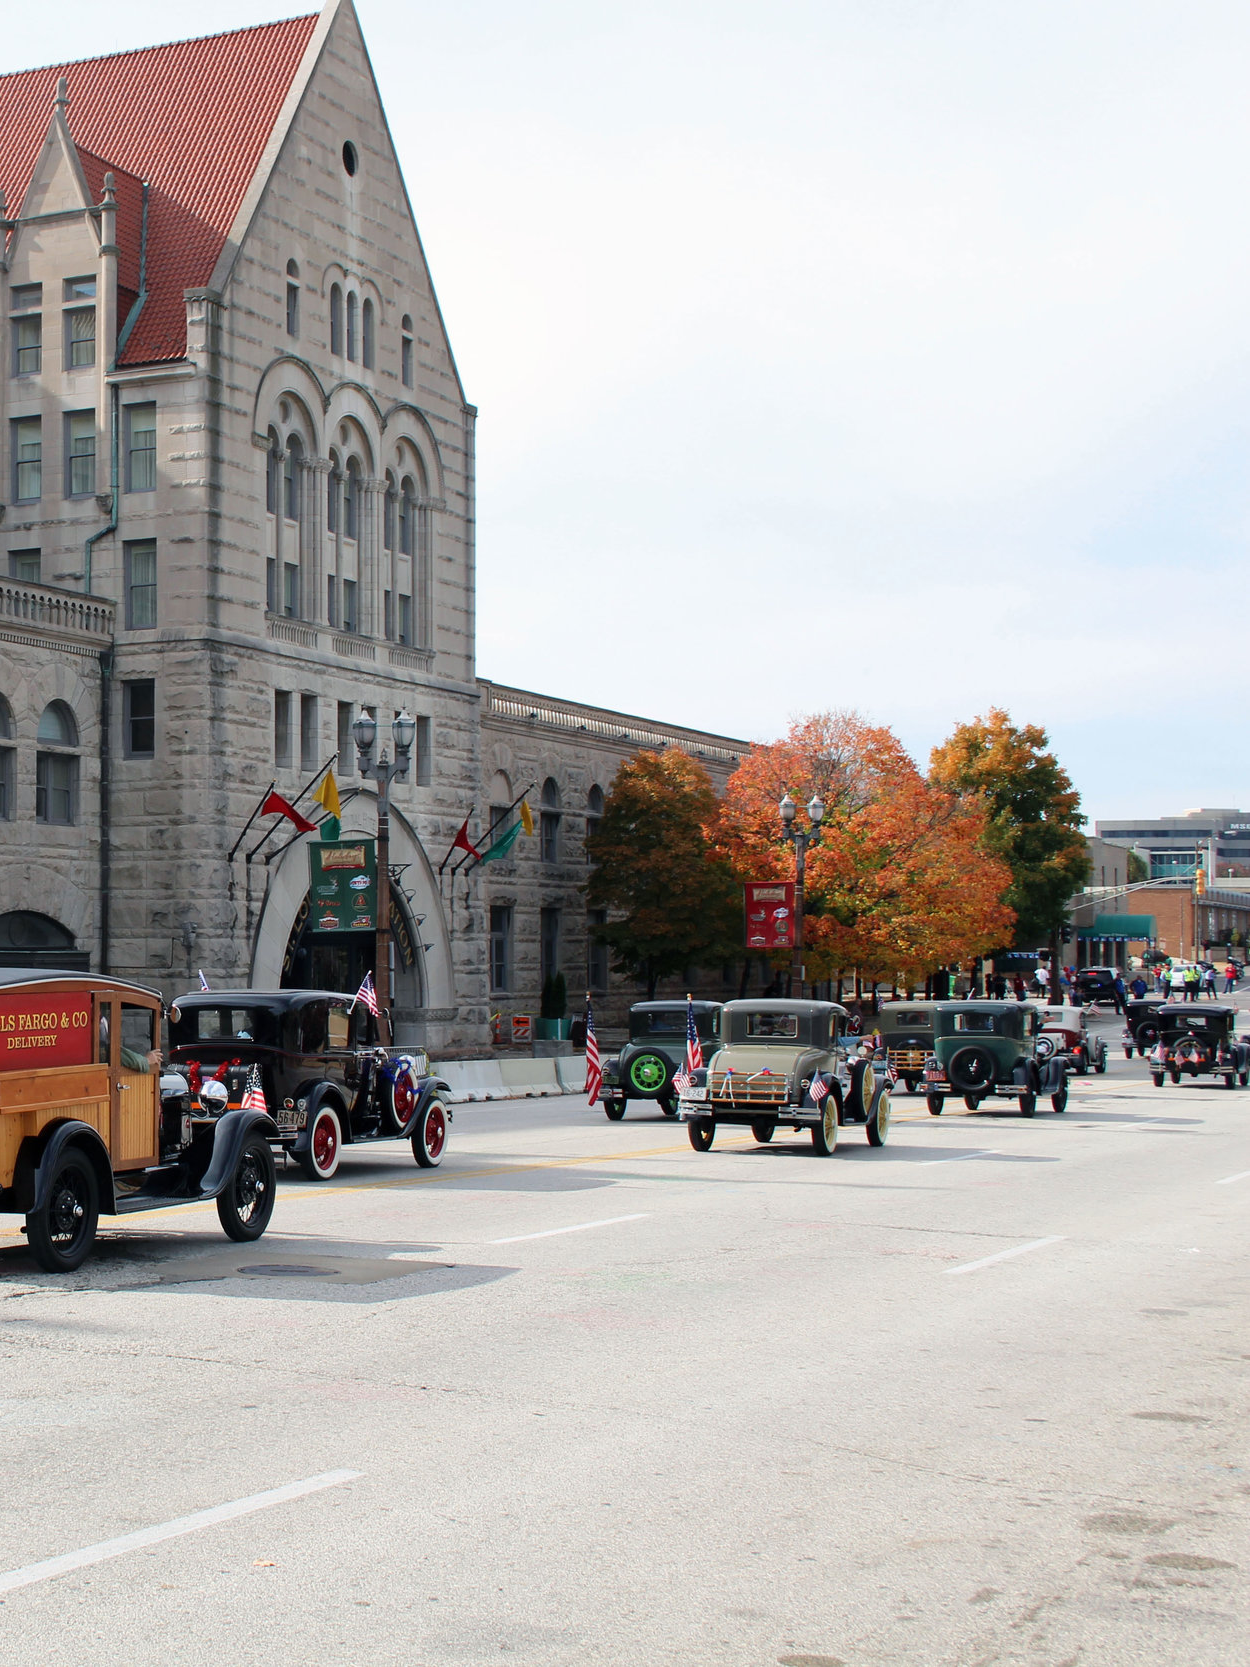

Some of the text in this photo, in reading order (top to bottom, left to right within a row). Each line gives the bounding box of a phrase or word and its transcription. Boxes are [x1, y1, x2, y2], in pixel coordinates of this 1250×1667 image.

[18, 1012, 58, 1031] FARGO
[60, 1012, 69, 1028] &
[72, 1011, 88, 1028] CO
[7, 1034, 57, 1050] DELIVERY
